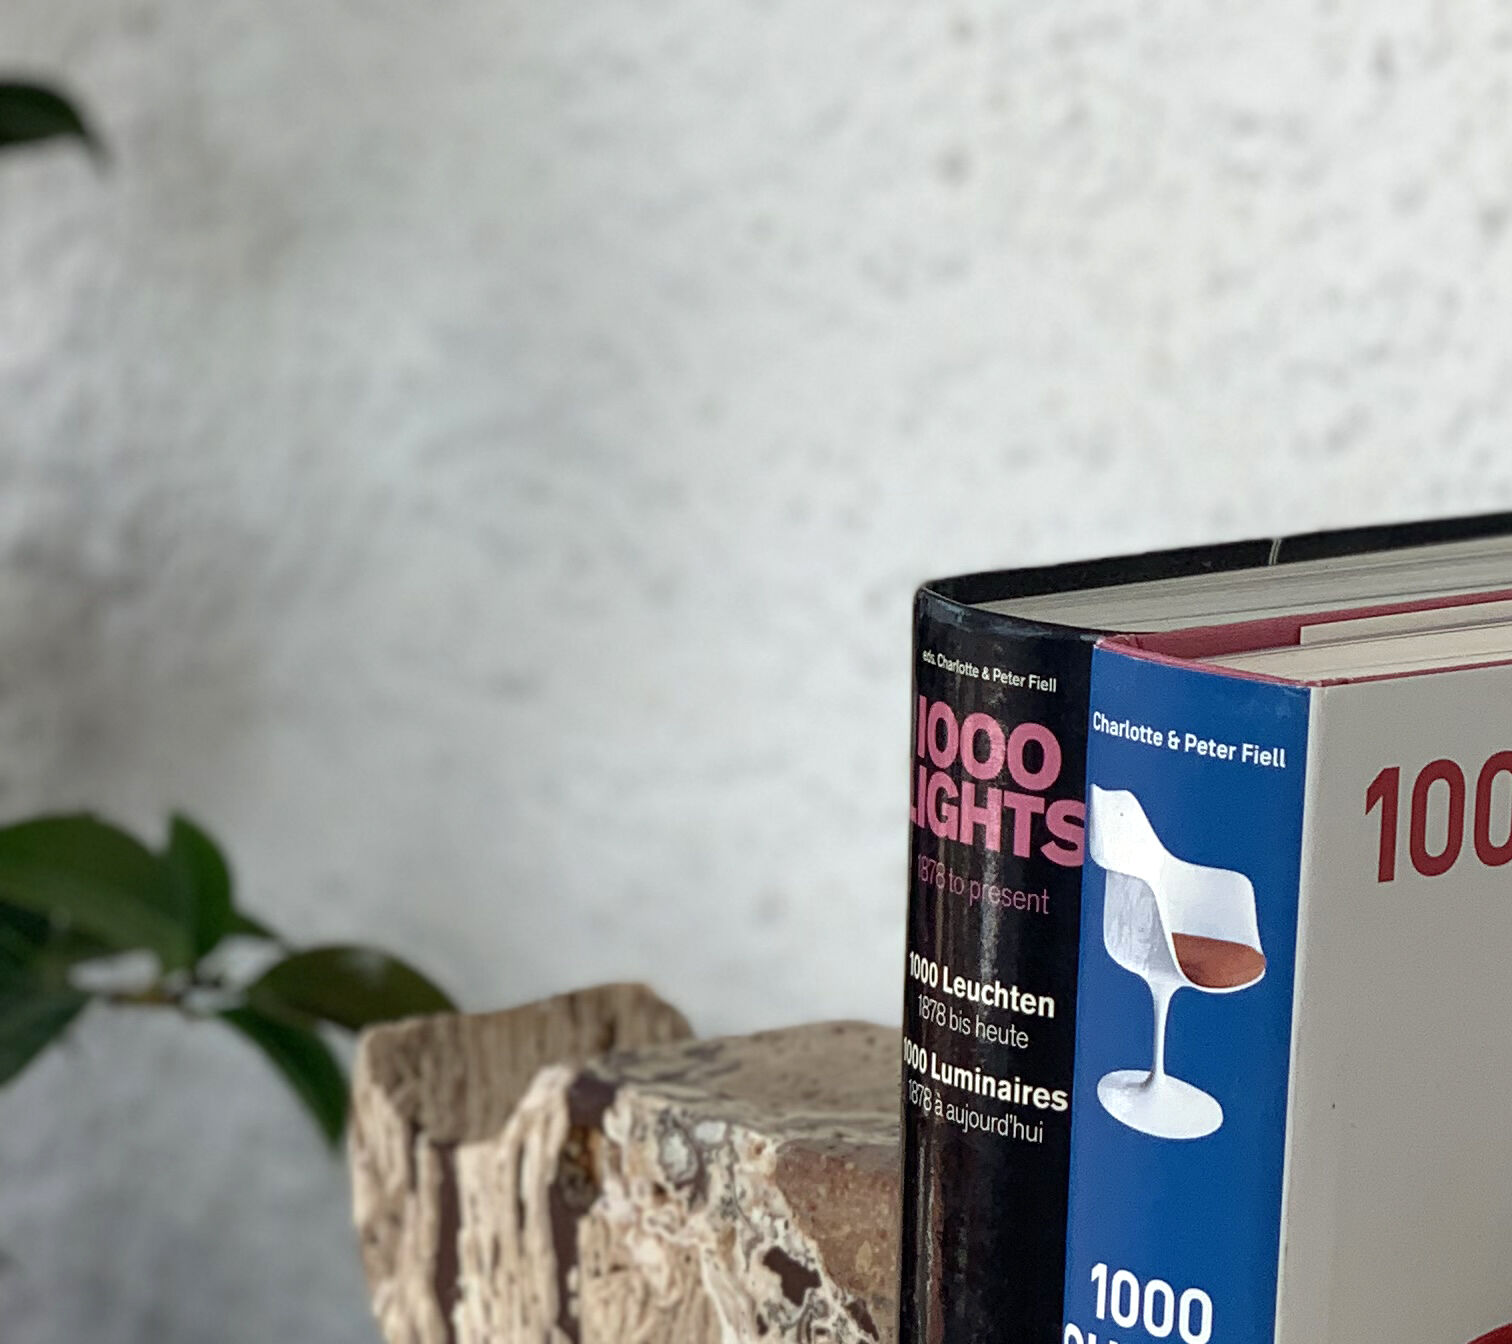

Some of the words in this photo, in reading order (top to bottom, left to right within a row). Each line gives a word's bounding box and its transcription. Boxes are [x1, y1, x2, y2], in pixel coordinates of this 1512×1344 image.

[937, 652, 979, 678] Charlotte
[981, 666, 990, 681] &
[993, 668, 1026, 687] Peter
[1029, 674, 1057, 693] Fiell
[916, 694, 1062, 791] 1000
[1093, 711, 1163, 747] Charlotte
[1168, 730, 1180, 750] &
[1184, 733, 1236, 761] Peter
[1241, 743, 1286, 768] Fiell
[918, 853, 945, 890] 1878
[949, 867, 965, 895] to
[969, 879, 1050, 915] present
[910, 950, 938, 989] 1000
[943, 965, 1055, 1018] Leuchten
[918, 993, 947, 1027] 1878
[949, 1006, 971, 1035] bis
[975, 1014, 1029, 1049] heute
[903, 1036, 927, 1075] 1000
[931, 1052, 1069, 1112] Luminaires
[908, 1078, 932, 1112] 1878
[934, 1087, 944, 1117] à
[946, 1103, 1044, 1144] aujourd'hui
